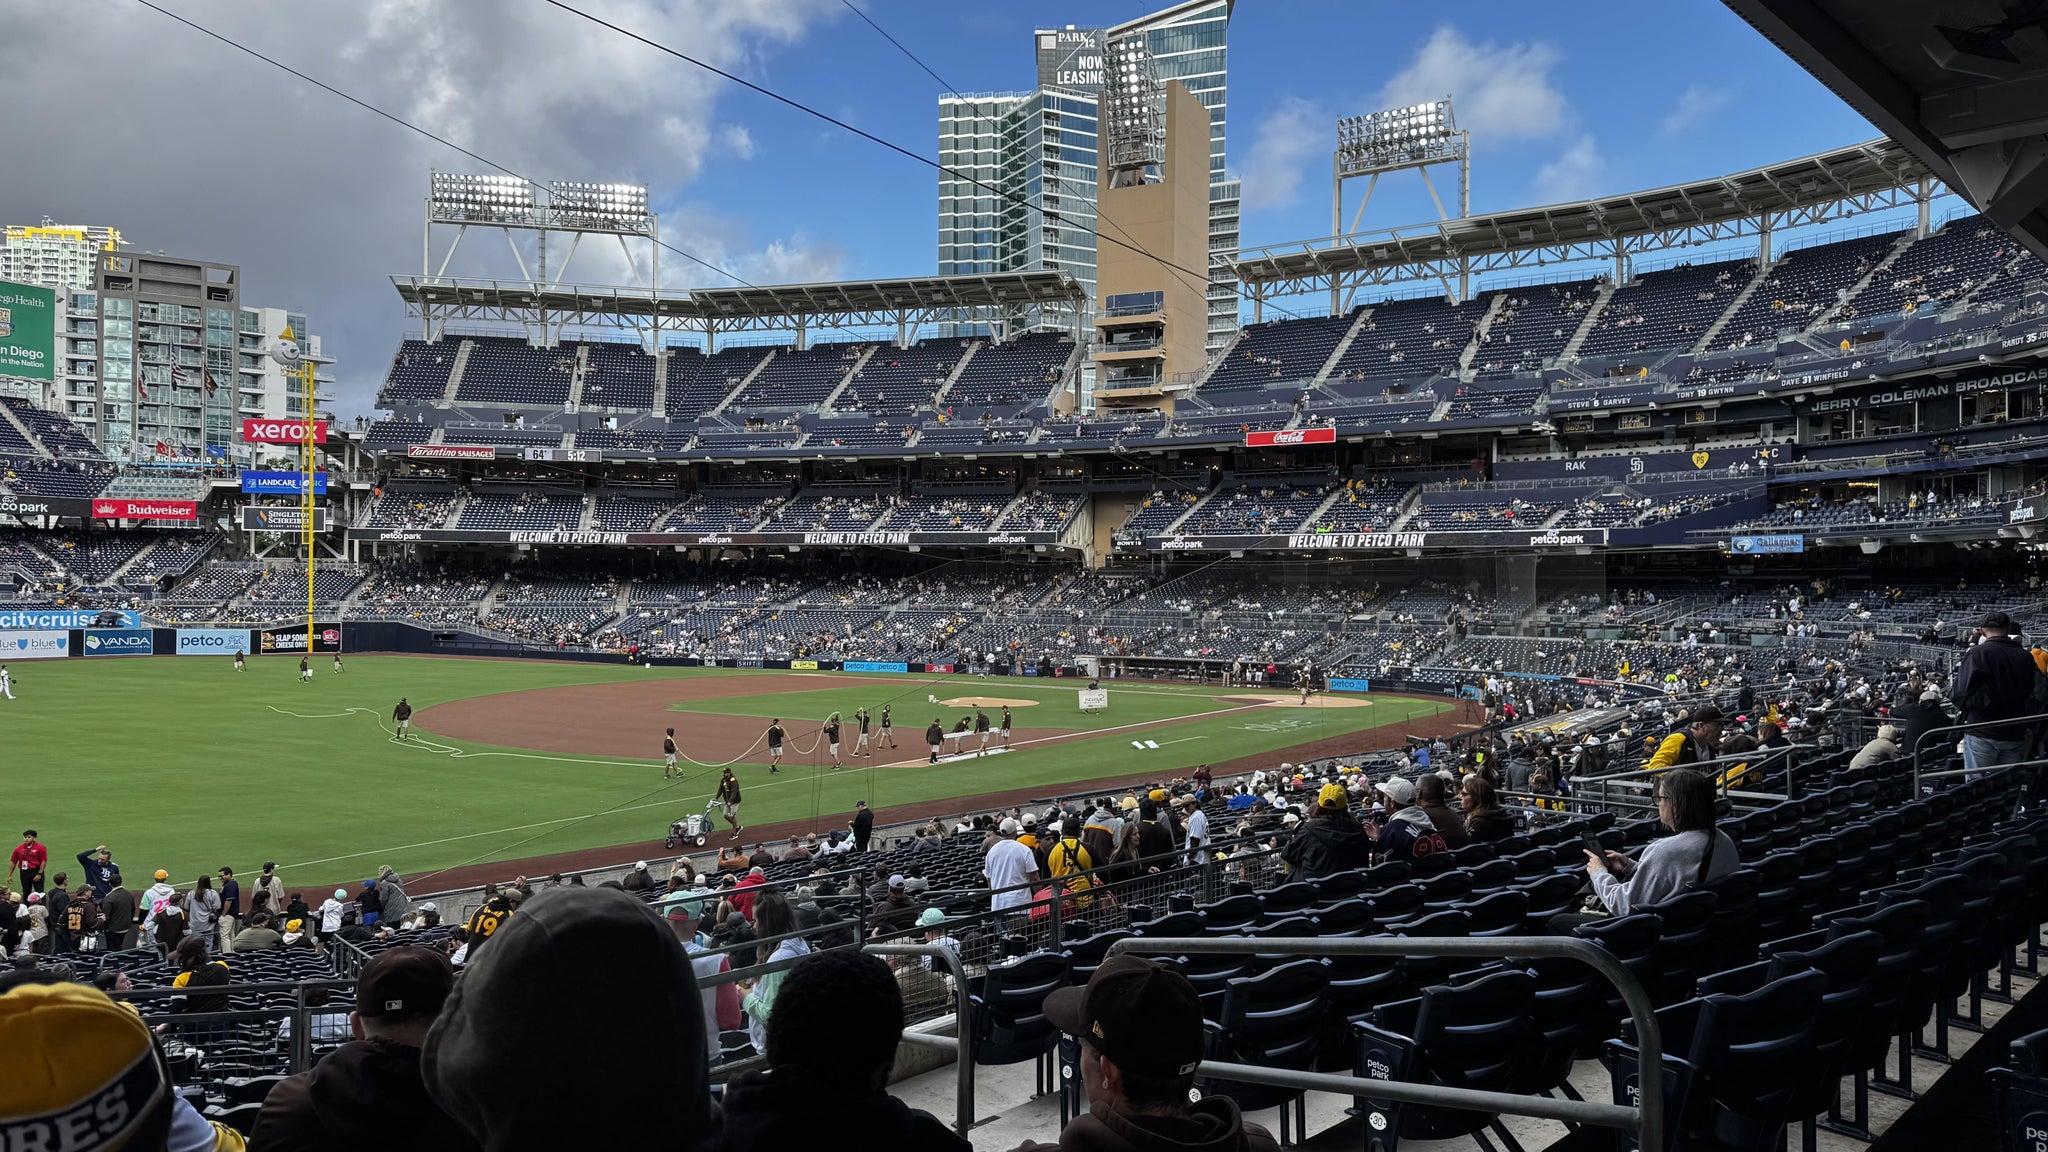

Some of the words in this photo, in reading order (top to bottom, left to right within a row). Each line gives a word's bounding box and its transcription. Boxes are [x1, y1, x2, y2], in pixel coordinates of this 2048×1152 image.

[1058, 33, 1087, 42] PARK
[1078, 56, 1103, 69] NOW
[1057, 71, 1105, 85] LEASING
[15, 294, 45, 308] Health
[2026, 332, 2037, 343] 35
[10, 345, 44, 359] Diego
[8, 358, 20, 366] the
[21, 360, 44, 368] Nation
[1781, 377, 1801, 387] DAVE
[1802, 375, 1812, 384] 31
[1813, 370, 1849, 382] WINFIELD
[1676, 391, 1694, 399] TONY
[1697, 388, 1707, 397] 19
[1708, 386, 1735, 396] GWYNN
[1811, 397, 1862, 412] JERRY
[1869, 384, 1949, 405] COLEMAN
[1955, 368, 2048, 393] BROADCAS
[1603, 397, 1632, 406] GARVEY
[251, 423, 318, 440] xerox
[410, 446, 456, 457] Tarantino
[567, 451, 586, 461] 5:12
[1696, 456, 1704, 464] PS
[1565, 461, 1586, 471] RAK
[19, 502, 49, 514] park
[127, 503, 191, 516] Budweiser
[380, 532, 403, 540] petco
[403, 532, 421, 540] park
[509, 532, 556, 543] WELCOME
[557, 532, 570, 543] TO
[571, 532, 602, 544] PETCO
[602, 533, 628, 544] PARK
[698, 535, 717, 543] petco
[717, 535, 733, 543] park
[804, 533, 845, 544] WELCOME
[845, 533, 857, 544] TO
[857, 533, 885, 544] PETCO
[885, 533, 910, 543] PARK
[988, 536, 1008, 544] petco
[1008, 535, 1026, 543] park
[1288, 534, 1339, 548] WELCOME
[1341, 534, 1354, 547] TO
[1357, 533, 1392, 547] PETCO
[1394, 533, 1425, 546] PARK
[1530, 535, 1560, 546] petco
[1560, 534, 1584, 546] park
[1161, 541, 1184, 550] petco
[1184, 540, 1203, 549] park
[31, 638, 56, 648] blue
[101, 636, 151, 646] VANDA
[181, 634, 224, 649] petco
[275, 634, 291, 642] SLAP
[292, 634, 309, 642] SOME
[275, 641, 295, 649] CHEESE
[878, 662, 897, 670] petco
[1331, 680, 1355, 690] petco
[1584, 805, 1600, 813] 116
[475, 914, 498, 937] 19
[1367, 1058, 1390, 1073] petco
[1371, 1068, 1390, 1081] park
[0, 1082, 130, 1152] RES
[1373, 1115, 1383, 1127] 30
